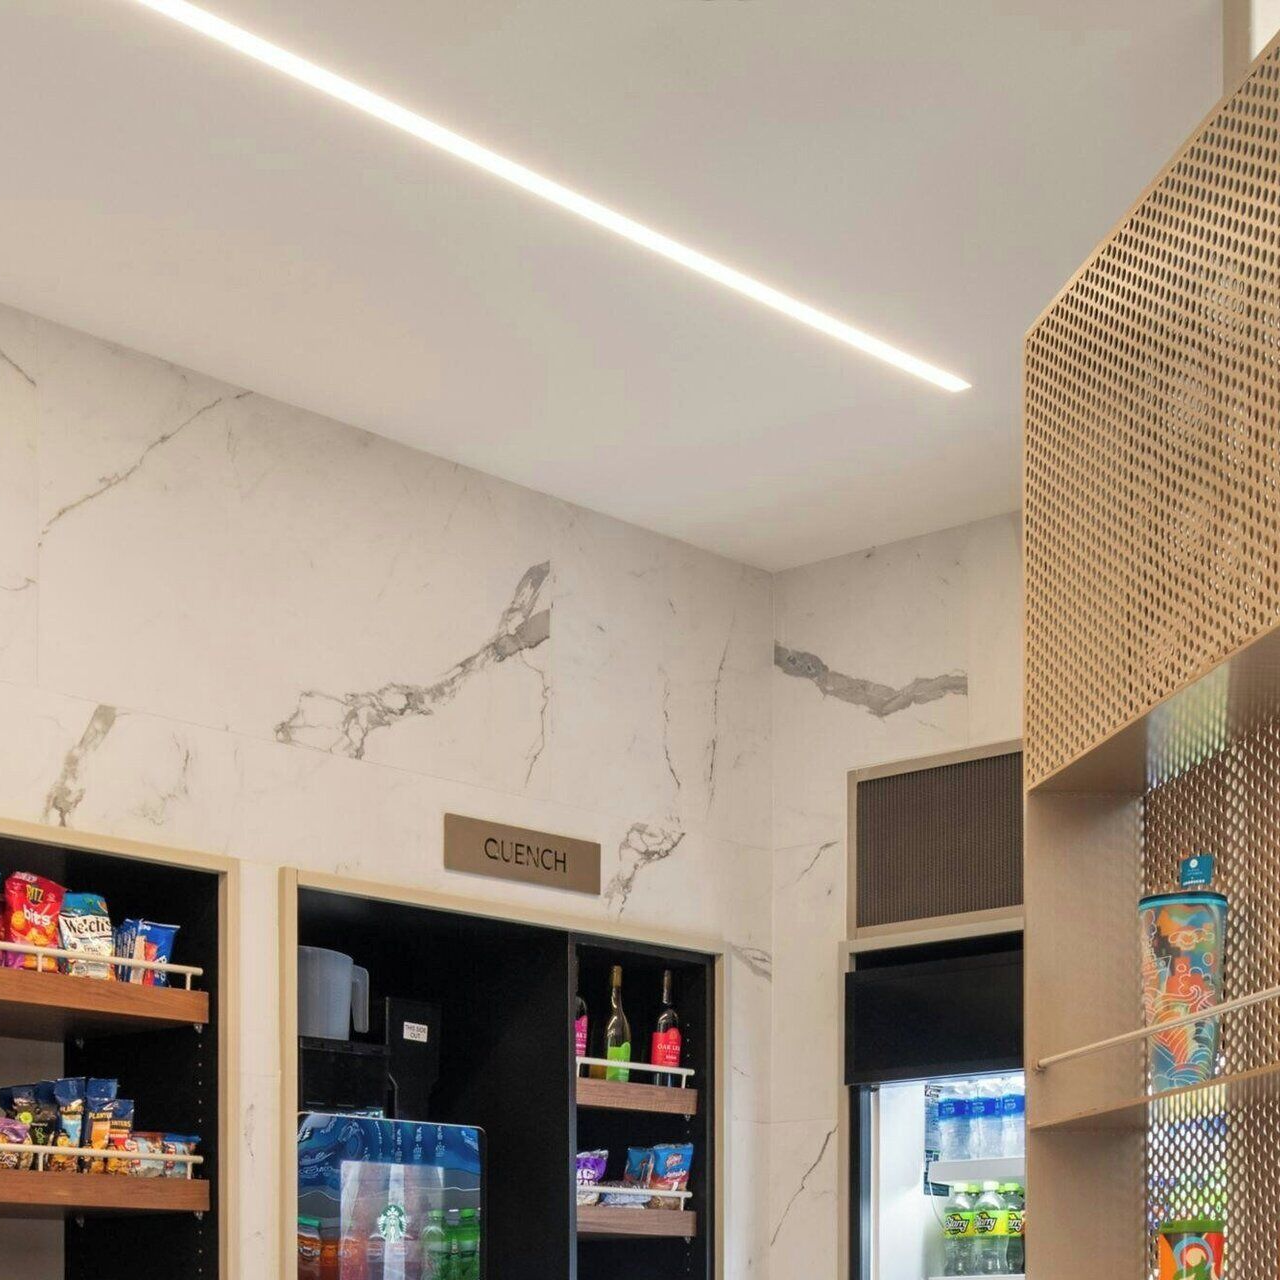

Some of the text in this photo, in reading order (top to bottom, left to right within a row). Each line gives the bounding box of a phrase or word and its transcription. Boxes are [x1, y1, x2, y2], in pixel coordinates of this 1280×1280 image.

[416, 1026, 427, 1034] SIDE
[657, 1043, 670, 1051] OAK
[945, 1217, 969, 1233] Starry
